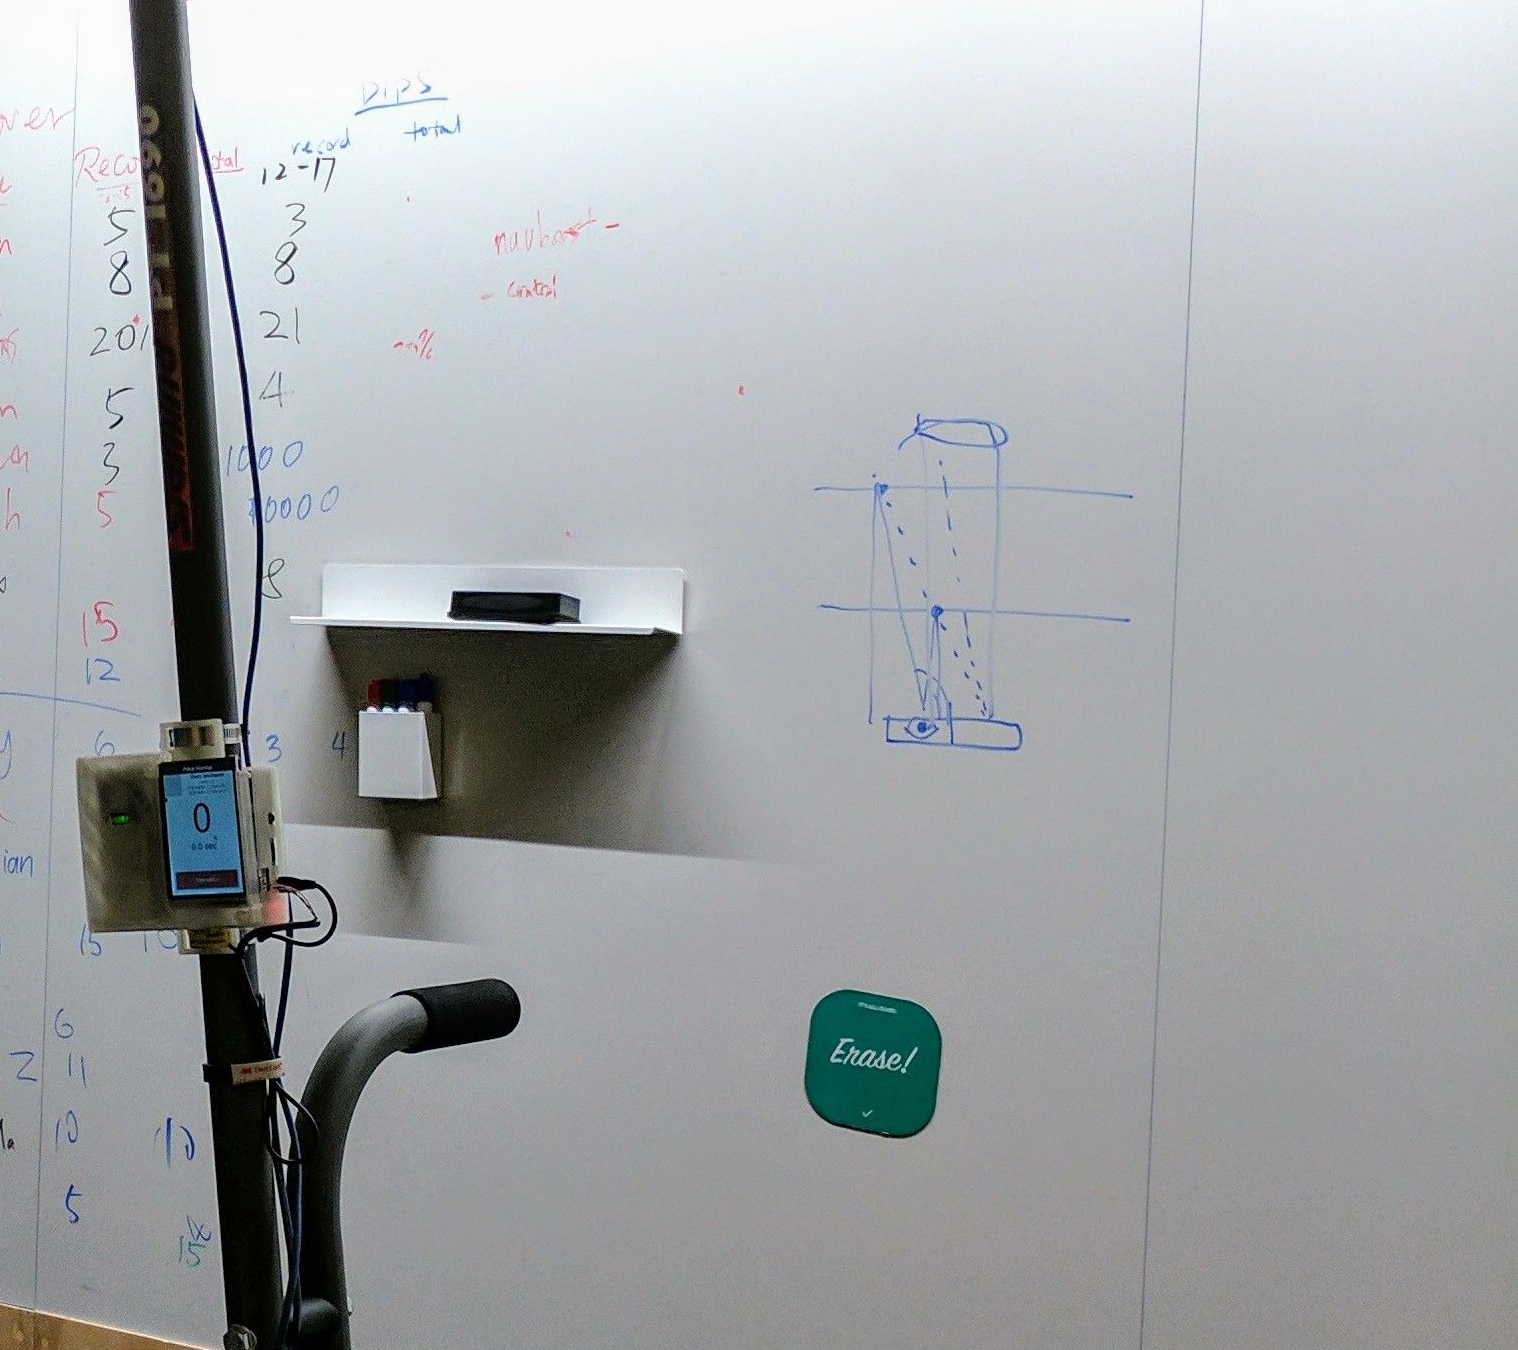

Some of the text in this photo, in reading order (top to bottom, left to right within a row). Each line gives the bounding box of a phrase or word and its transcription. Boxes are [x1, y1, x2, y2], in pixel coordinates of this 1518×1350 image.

[108, 250, 132, 296] 8
[274, 241, 298, 285] 8
[259, 306, 302, 345] 21
[84, 657, 121, 686] 12
[265, 733, 283, 763] 3
[193, 802, 211, 834] 0
[829, 1037, 919, 1074] Erase!
